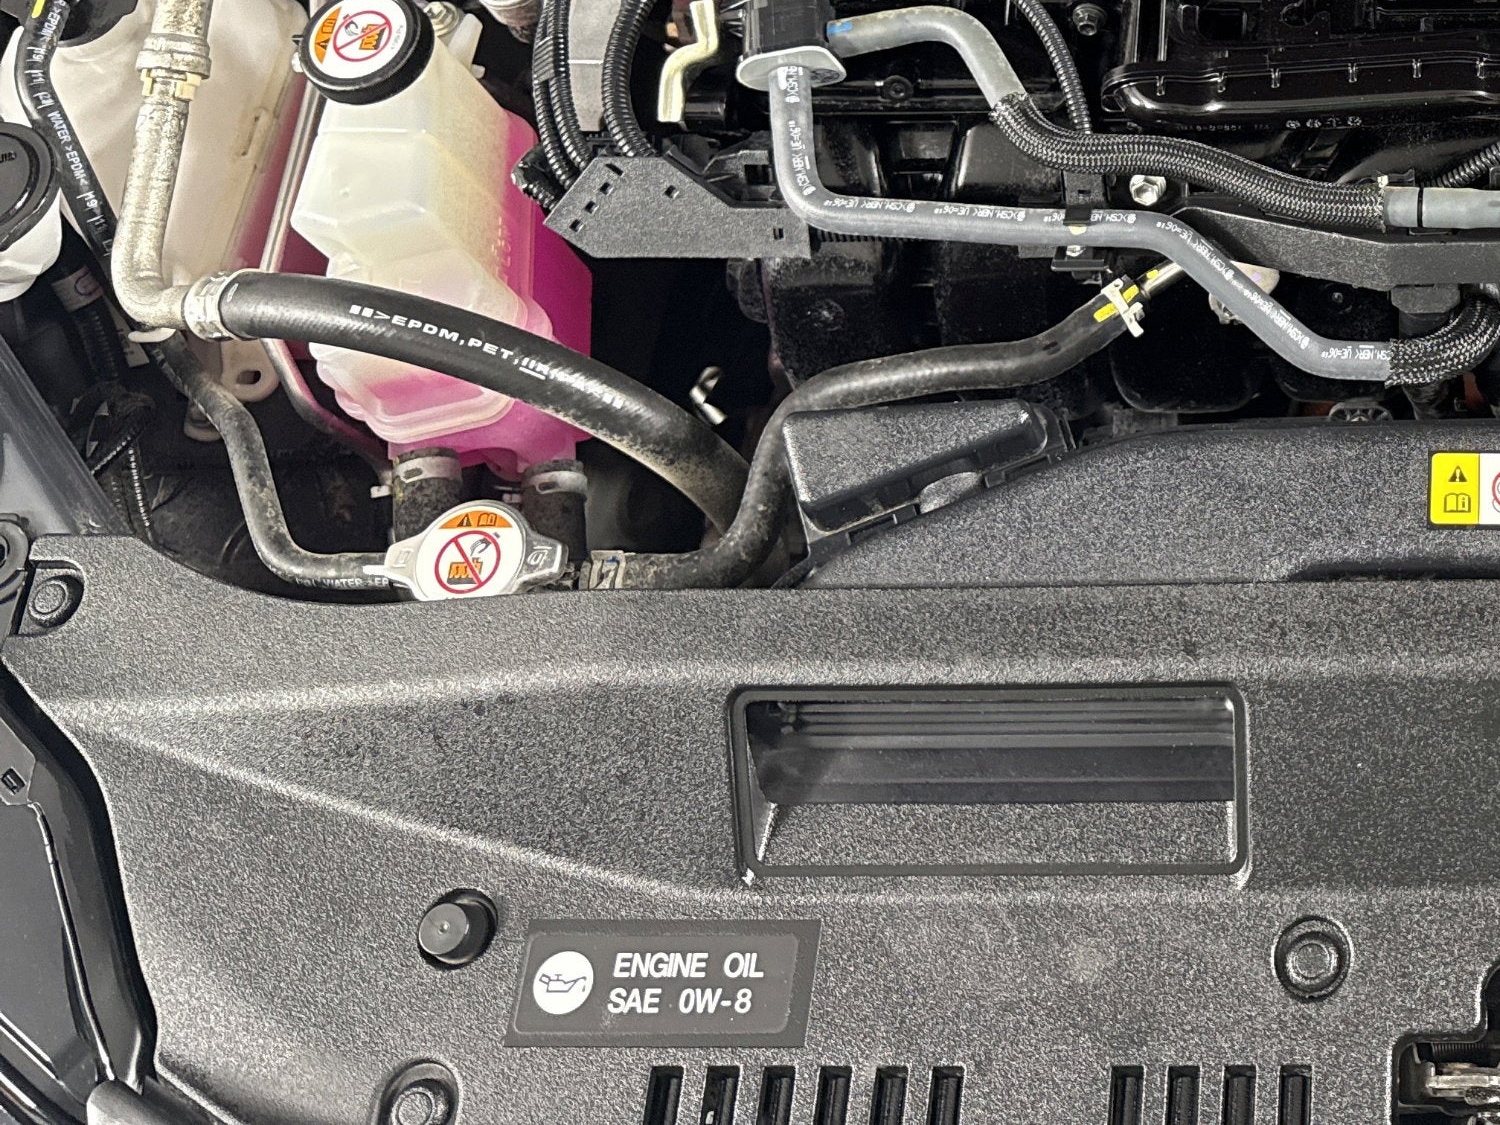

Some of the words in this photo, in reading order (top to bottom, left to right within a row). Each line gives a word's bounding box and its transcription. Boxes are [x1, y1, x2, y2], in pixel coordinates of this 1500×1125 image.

[47, 110, 71, 144] WATER
[613, 952, 708, 978] ENGINE
[723, 952, 764, 978] OIL
[607, 988, 662, 1014] SAE
[678, 988, 752, 1014] 0W-8
